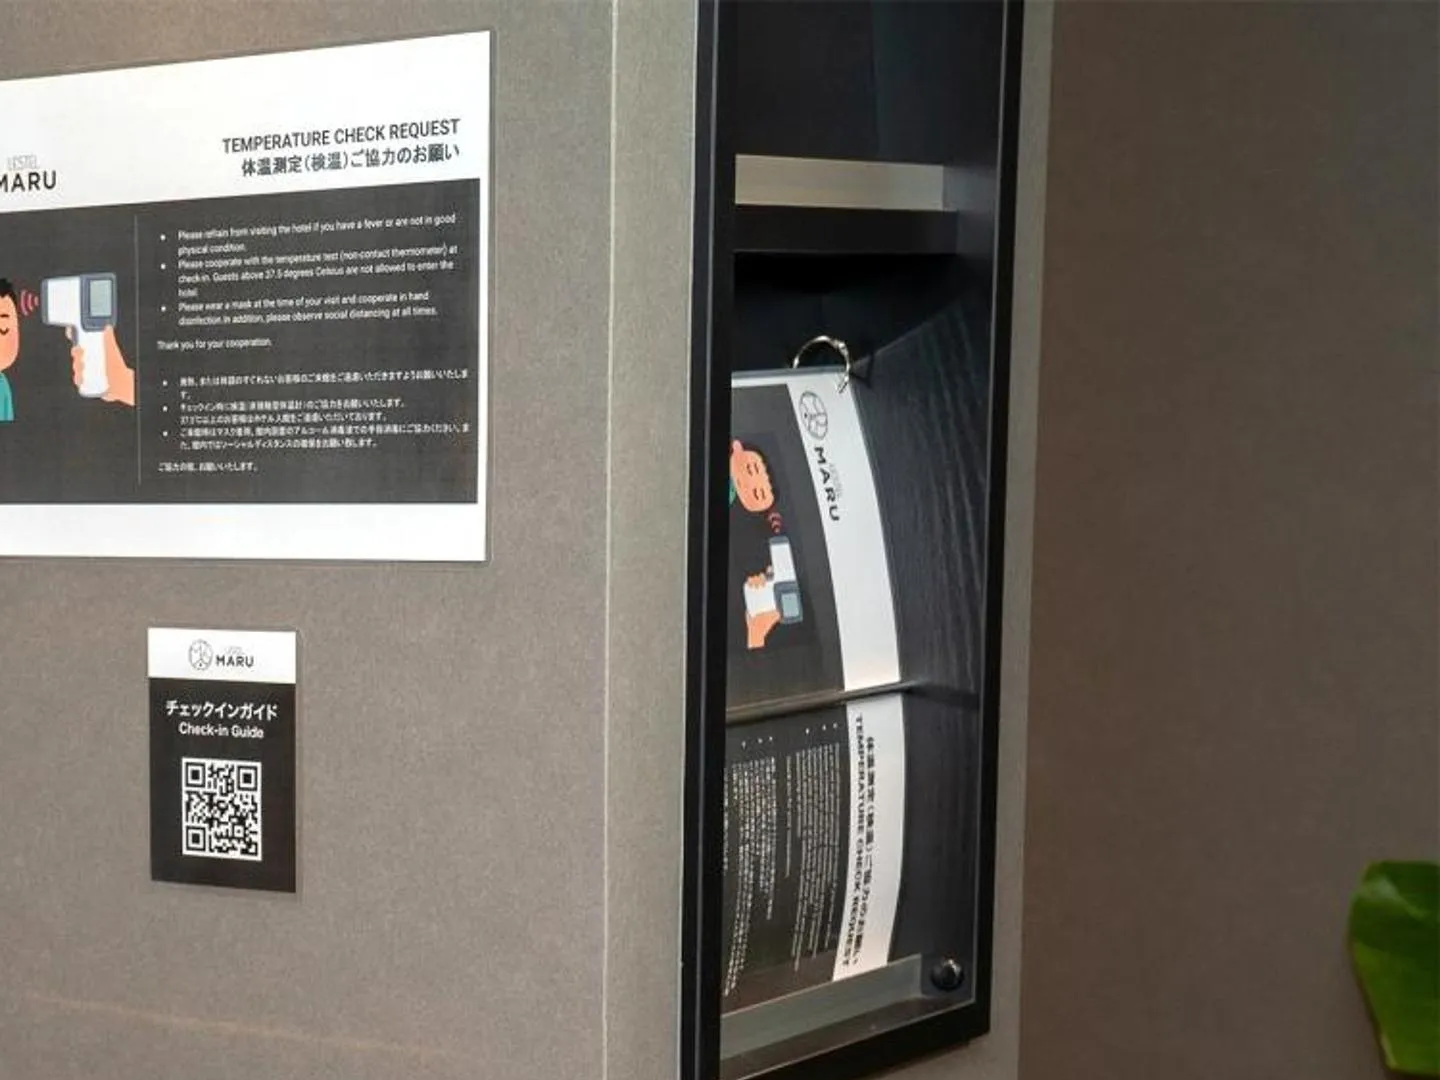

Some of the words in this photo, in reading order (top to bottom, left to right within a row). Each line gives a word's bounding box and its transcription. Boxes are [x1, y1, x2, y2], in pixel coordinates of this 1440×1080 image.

[222, 130, 330, 154] TEMPERATURE
[334, 124, 386, 144] CHECK
[389, 118, 461, 140] REQUEST
[434, 213, 456, 226] good
[814, 446, 840, 521] MARU
[215, 654, 255, 669] MARU
[165, 700, 278, 721] チェックインガイド
[178, 721, 229, 737] Check-in
[231, 725, 265, 739] Guide
[855, 716, 866, 832] TEMPERATURE
